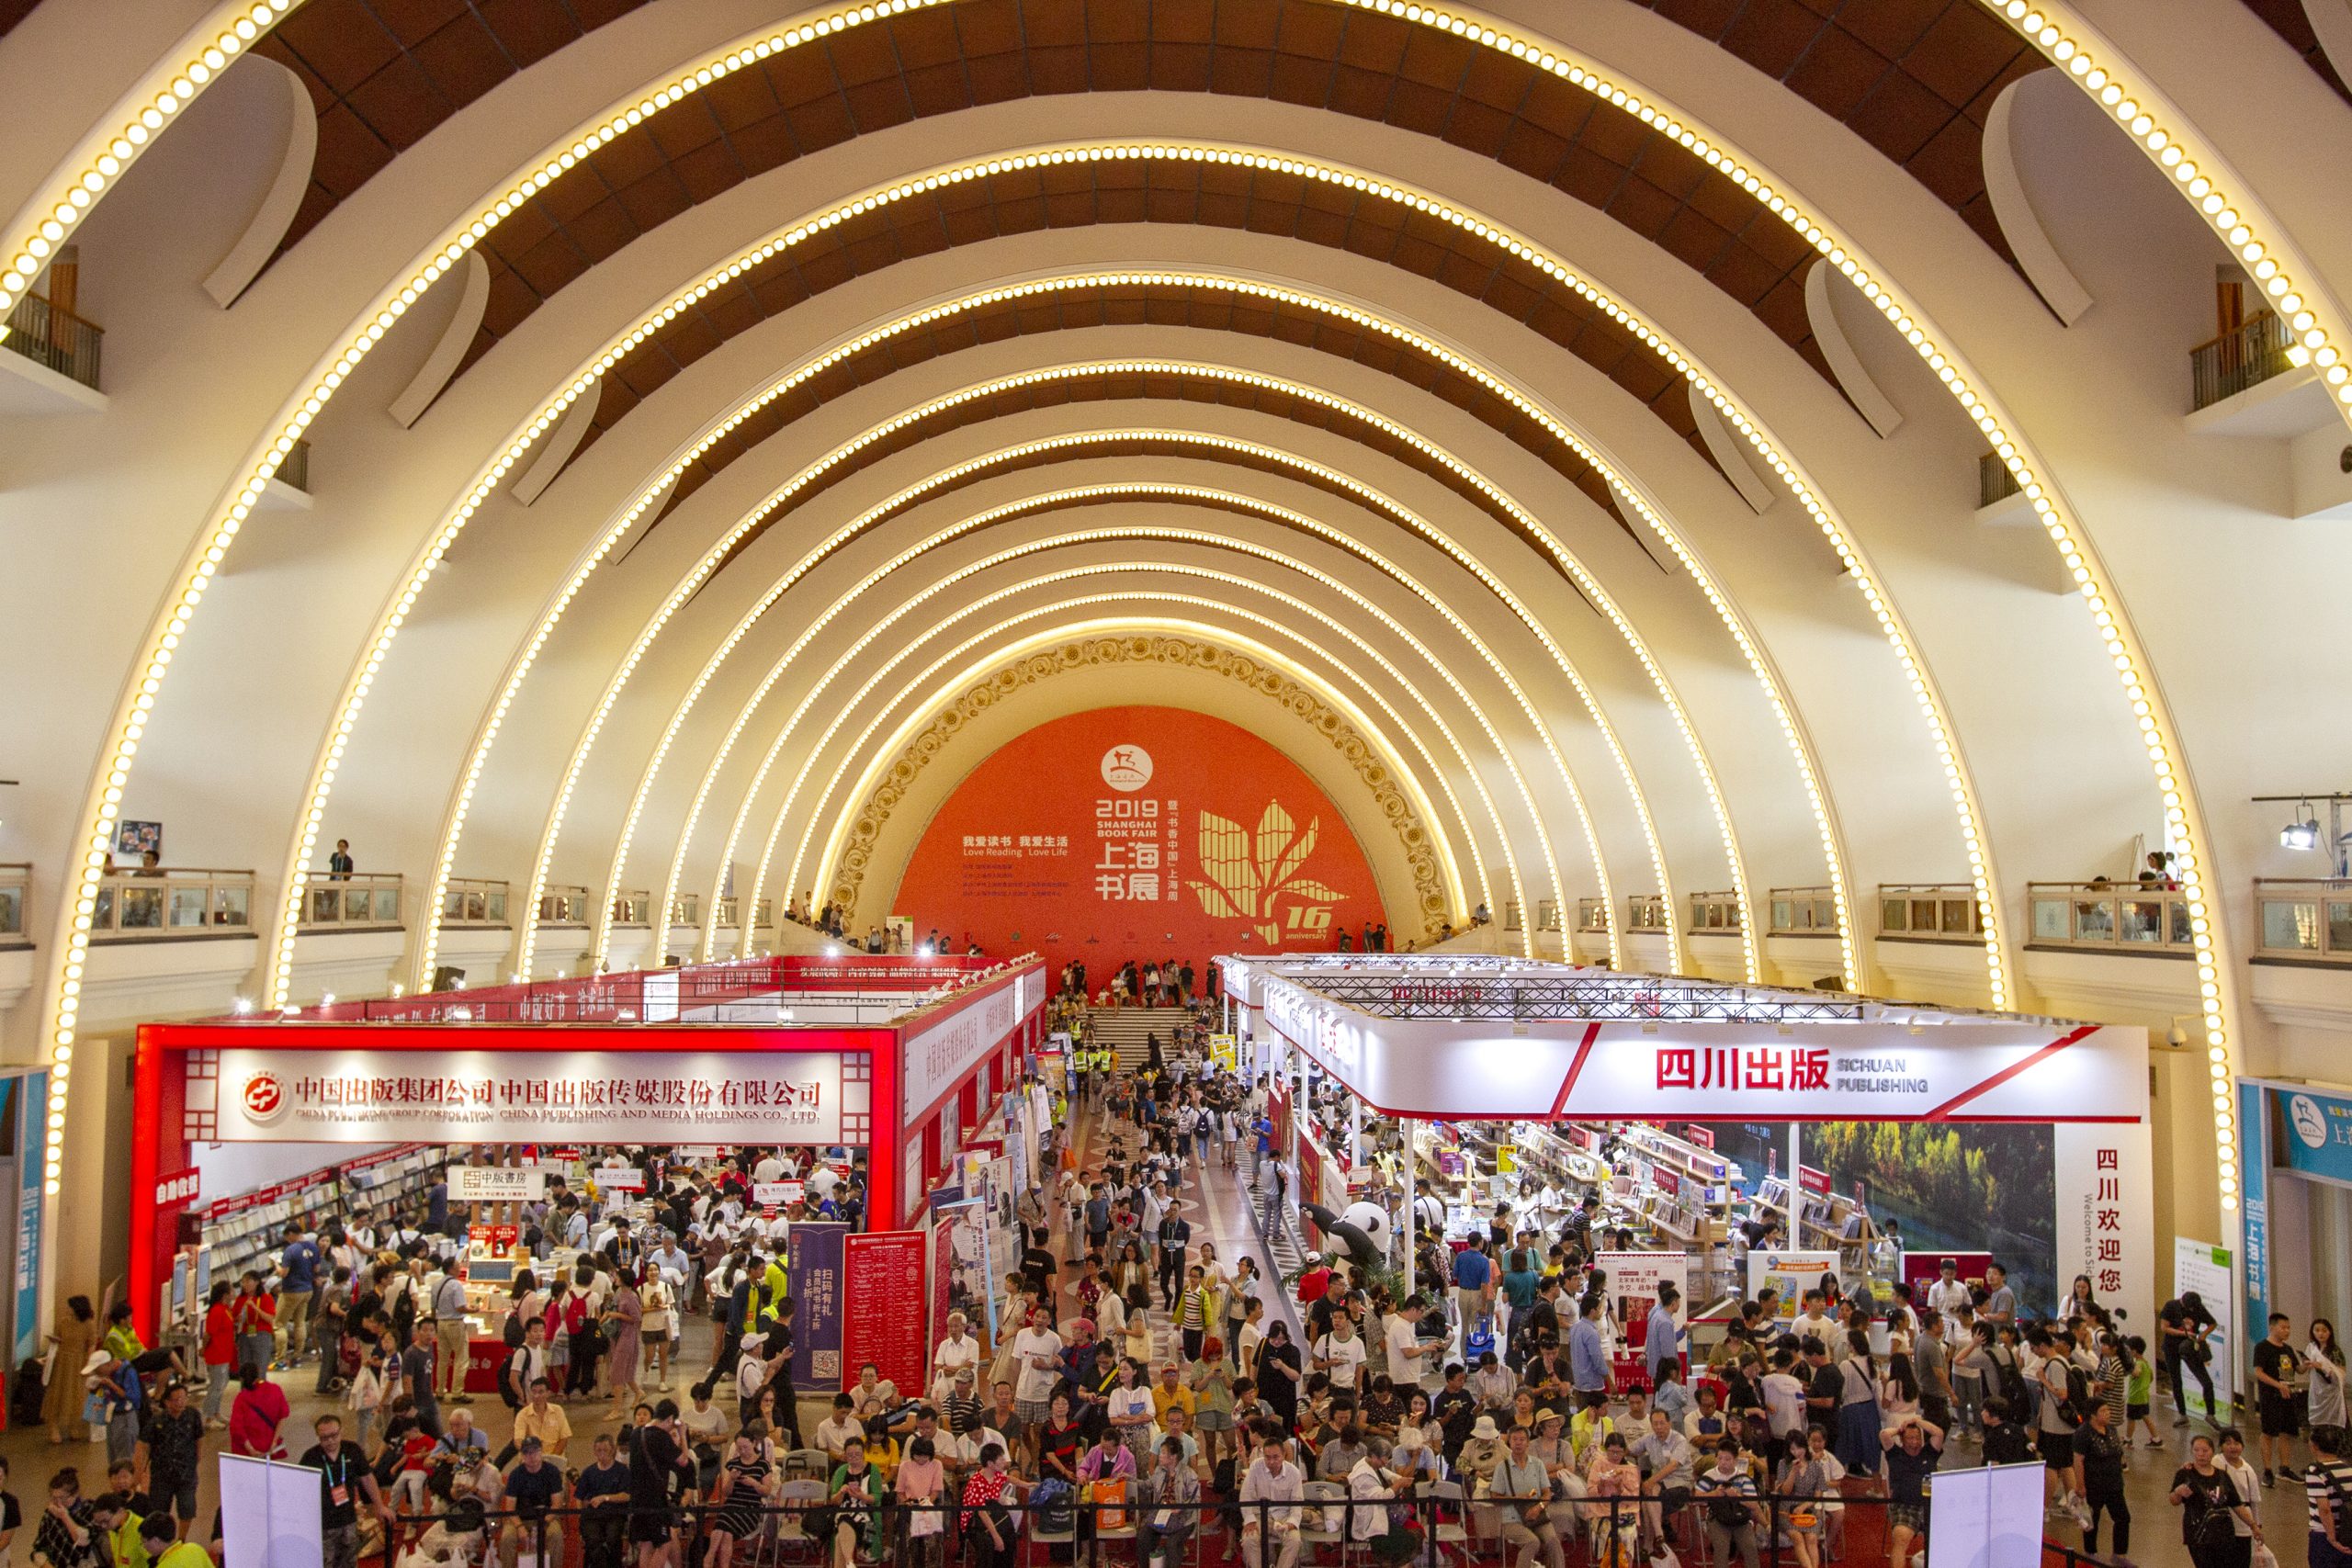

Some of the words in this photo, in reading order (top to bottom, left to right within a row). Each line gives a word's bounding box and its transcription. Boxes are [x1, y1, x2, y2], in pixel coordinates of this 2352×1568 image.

[1095, 800, 1159, 818] 2019
[963, 836, 1012, 847] 我爱读书
[1019, 836, 1068, 847] 我爱生活
[1097, 829, 1128, 838] BOOK
[1132, 829, 1157, 838] FAIR
[963, 848, 984, 856] Love
[986, 848, 1023, 858] Reading
[1028, 848, 1049, 856] Love
[1051, 848, 1068, 856] Life
[1095, 841, 1159, 869] 上海
[1095, 873, 1159, 901] 书展
[1286, 907, 1333, 929] 16
[1285, 932, 1327, 941] anniversary
[1657, 1047, 1830, 1092] 四川出版
[1837, 1058, 1906, 1073] SICHUAN
[296, 1077, 493, 1104] 中国出版集团公司
[500, 1078, 821, 1107] 中国出版传媒股份有限公司
[1837, 1078, 1928, 1093] PUBLISHING
[389, 1109, 421, 1117] GROUP
[500, 1109, 539, 1119] CHINA
[543, 1110, 616, 1119] PUBLISHING
[620, 1110, 648, 1119] AND
[650, 1110, 691, 1119] MEDIA
[695, 1110, 759, 1120] HOLDINGS
[2084, 1194, 2093, 1244] Welcome
[2097, 1149, 2121, 1292] 四川欢迎您
[2085, 1246, 2092, 1257] to
[822, 1269, 833, 1315] 扫码有礼
